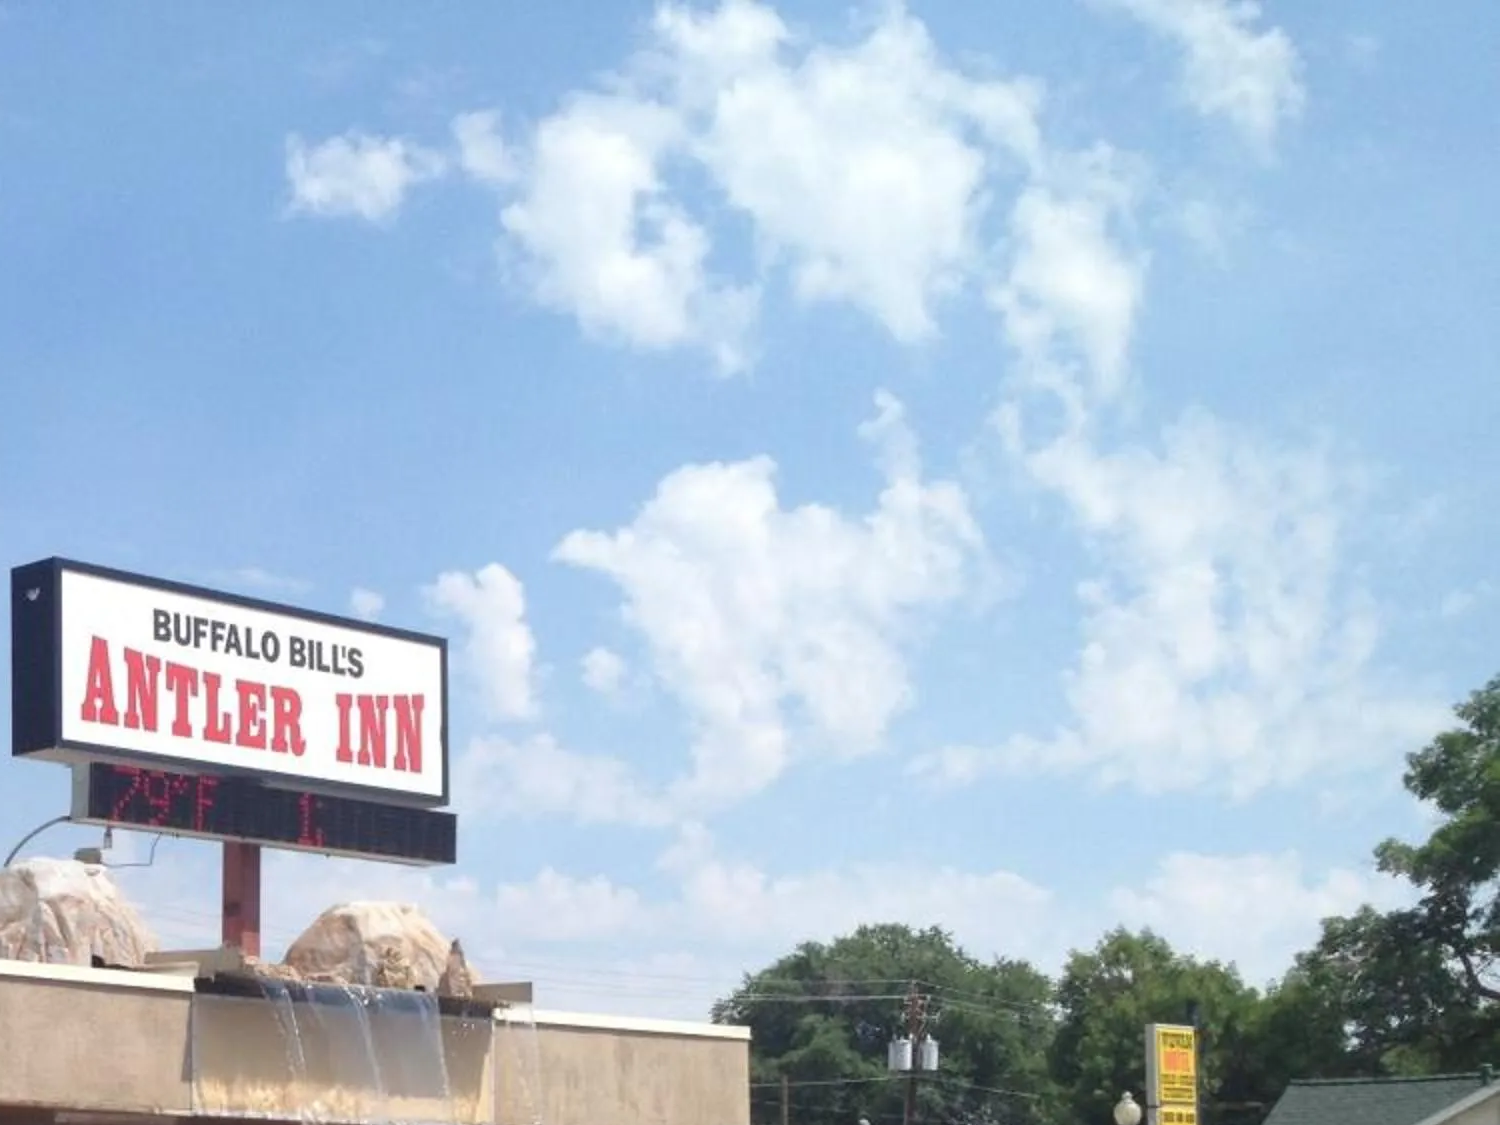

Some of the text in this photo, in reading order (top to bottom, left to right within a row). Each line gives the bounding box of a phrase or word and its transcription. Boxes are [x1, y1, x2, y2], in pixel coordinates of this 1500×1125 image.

[153, 608, 364, 679] BUFFALO BILL'S
[81, 634, 424, 773] ANTLER INN
